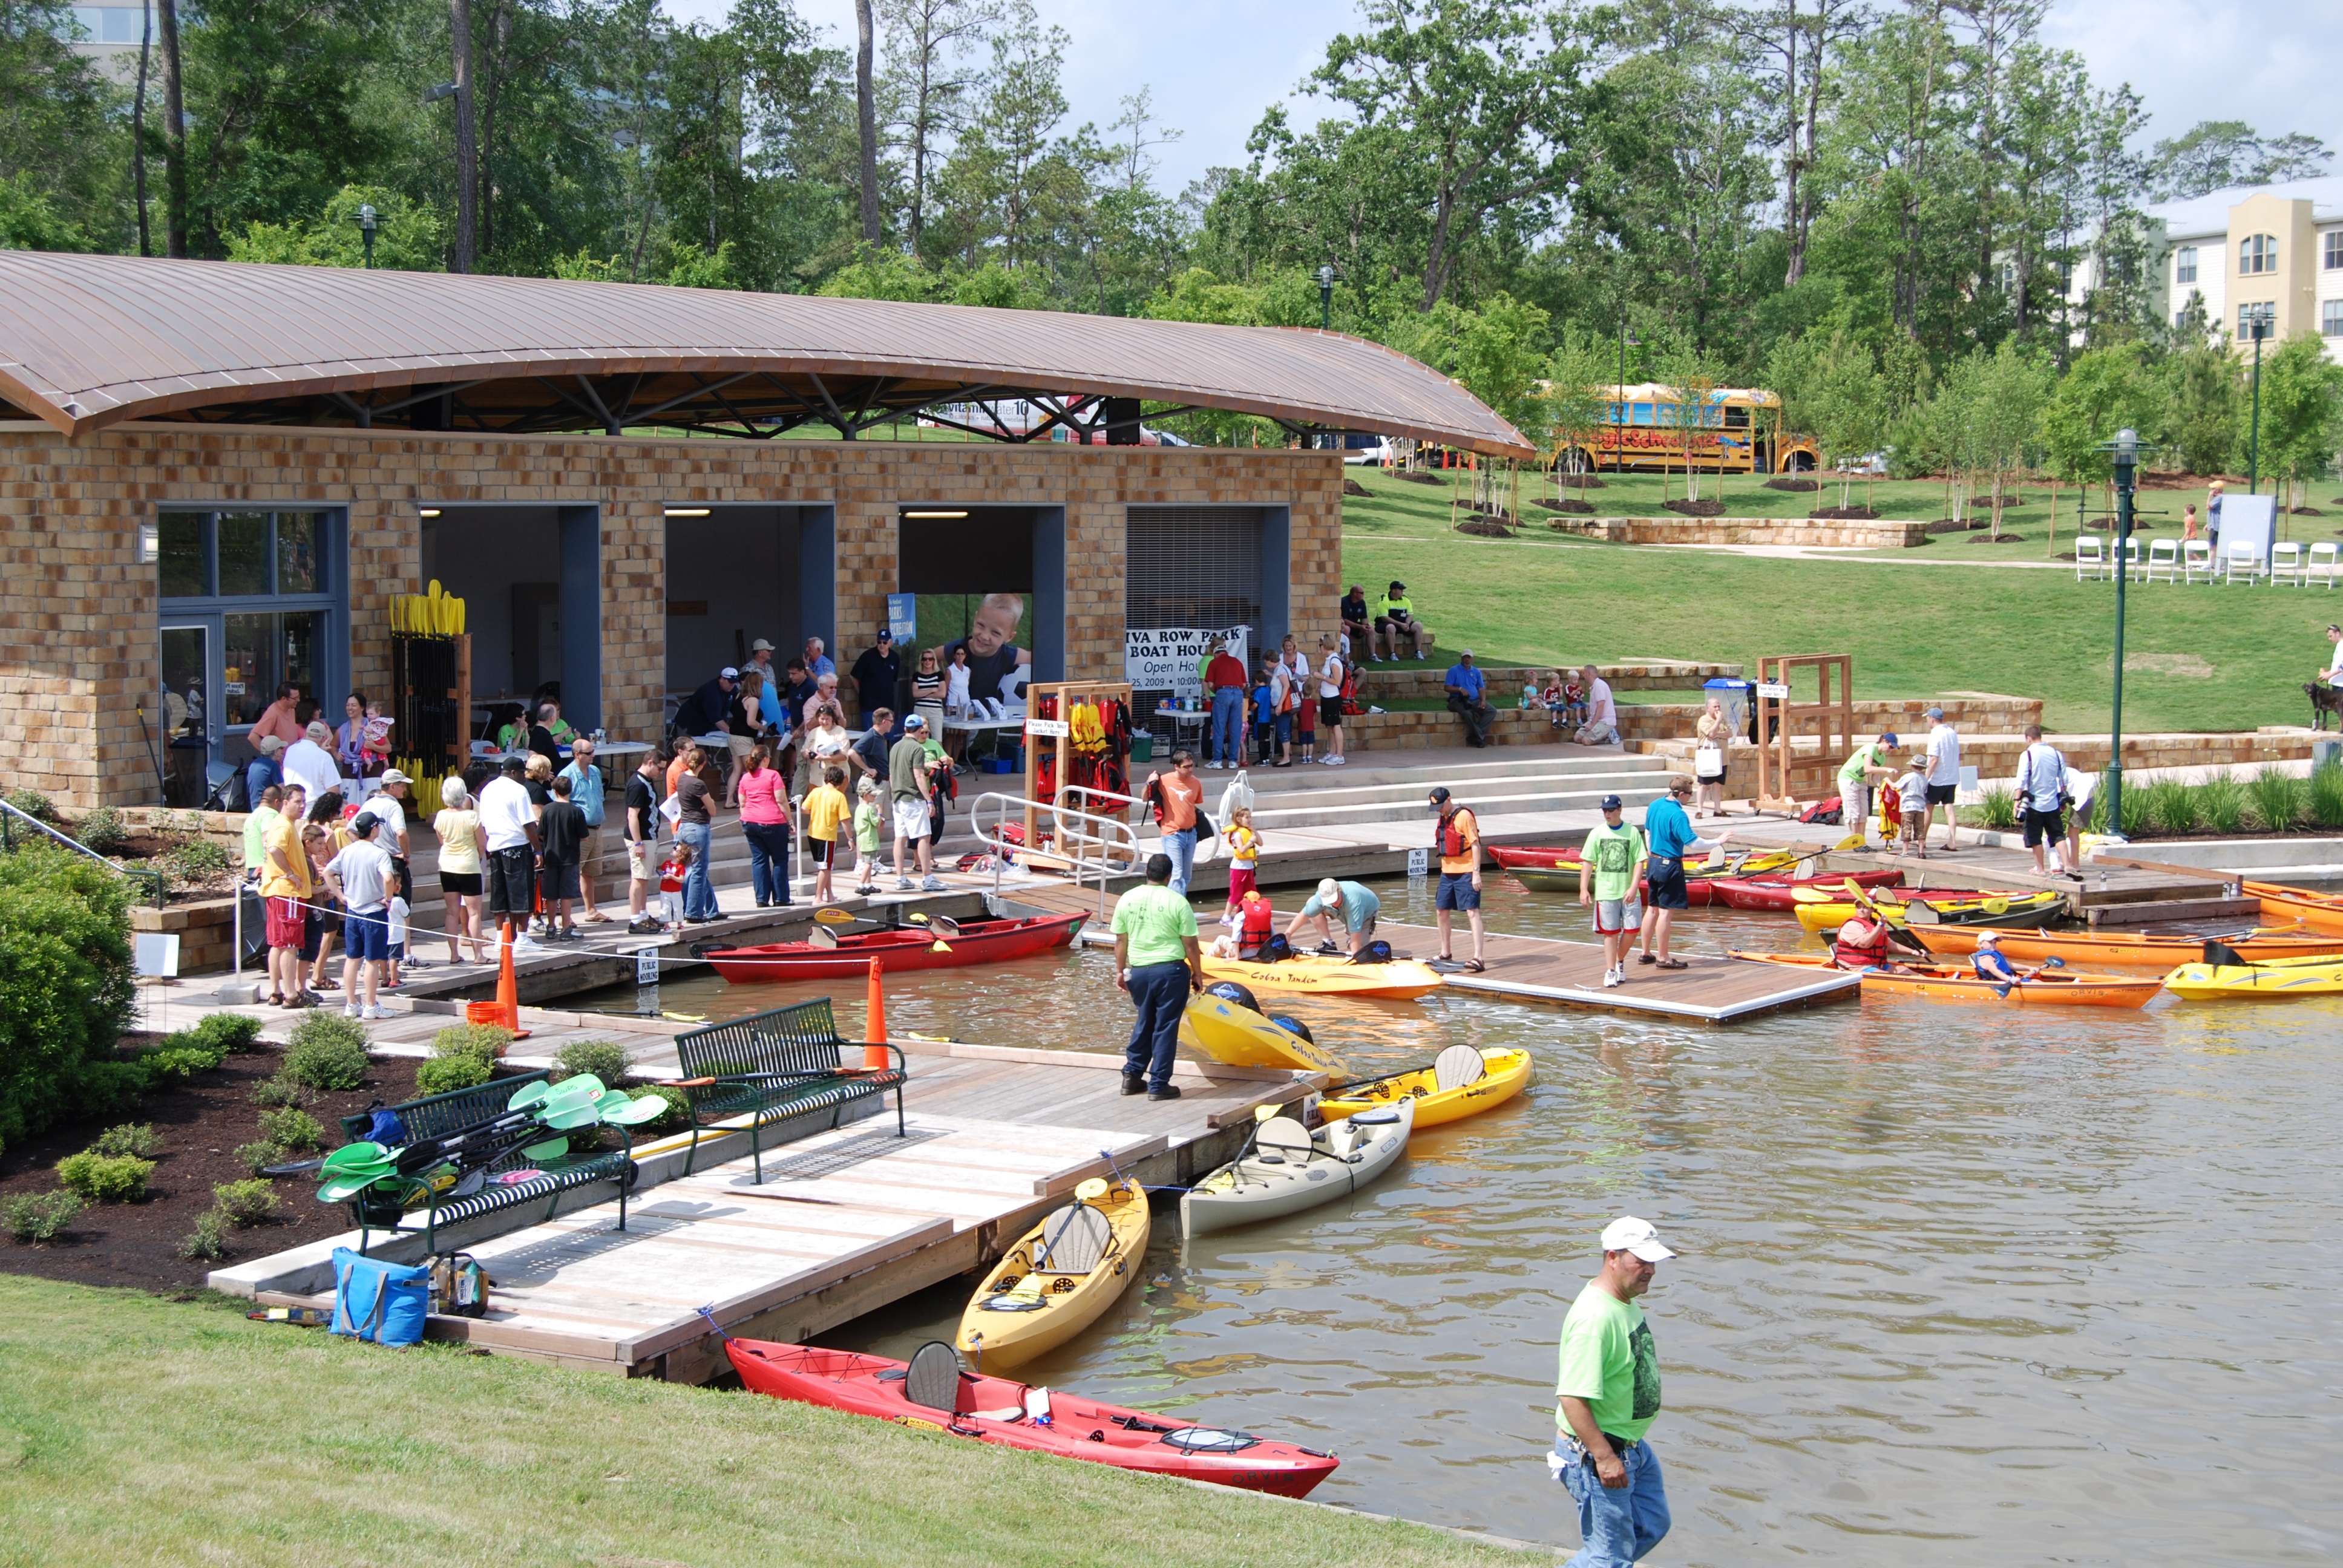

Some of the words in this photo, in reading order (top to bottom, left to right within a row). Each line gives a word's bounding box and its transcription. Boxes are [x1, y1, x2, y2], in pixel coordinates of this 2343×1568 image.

[890, 621, 913, 636] ECREATION
[1126, 632, 1151, 643] IVA
[1159, 631, 1194, 642] ROW
[1201, 628, 1240, 642] PARK
[1130, 645, 1170, 658] BOAT
[1176, 644, 1208, 656] HOU
[1144, 661, 1173, 675] Open
[1179, 661, 1199, 671] Hou
[1132, 678, 1142, 687] 25,
[1145, 678, 1165, 687] 2009
[1177, 677, 1201, 685] 10:00a
[641, 961, 656, 970] PUBLIC
[1288, 973, 1317, 984] Tandem
[2071, 988, 2104, 997] ORVIS
[1231, 1470, 1294, 1484] ORVIS
